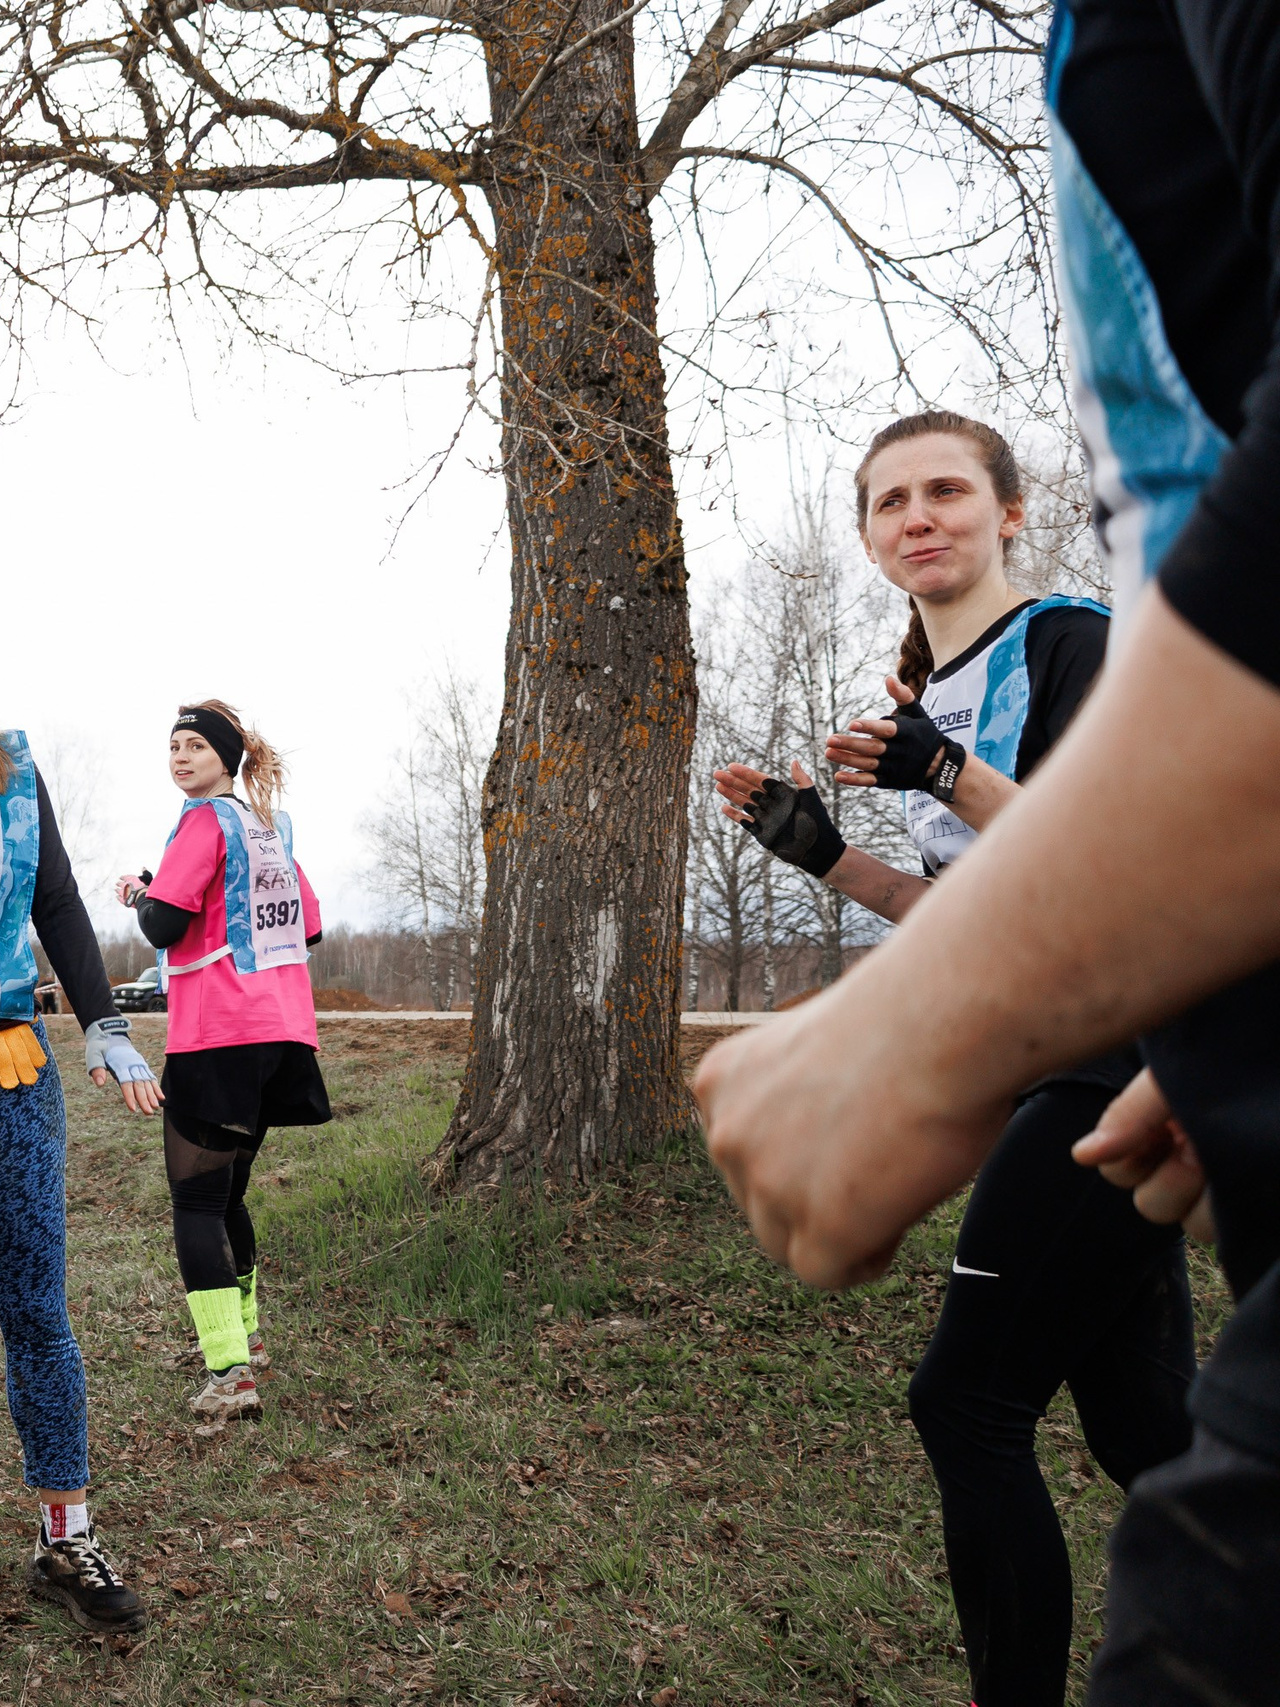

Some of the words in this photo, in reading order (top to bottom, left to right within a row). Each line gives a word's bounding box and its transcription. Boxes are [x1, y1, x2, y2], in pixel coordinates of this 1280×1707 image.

[933, 708, 972, 728] ЕРОЕВ
[938, 759, 953, 787] SPORT
[946, 765, 958, 788] GURU
[257, 899, 299, 930] 5397
